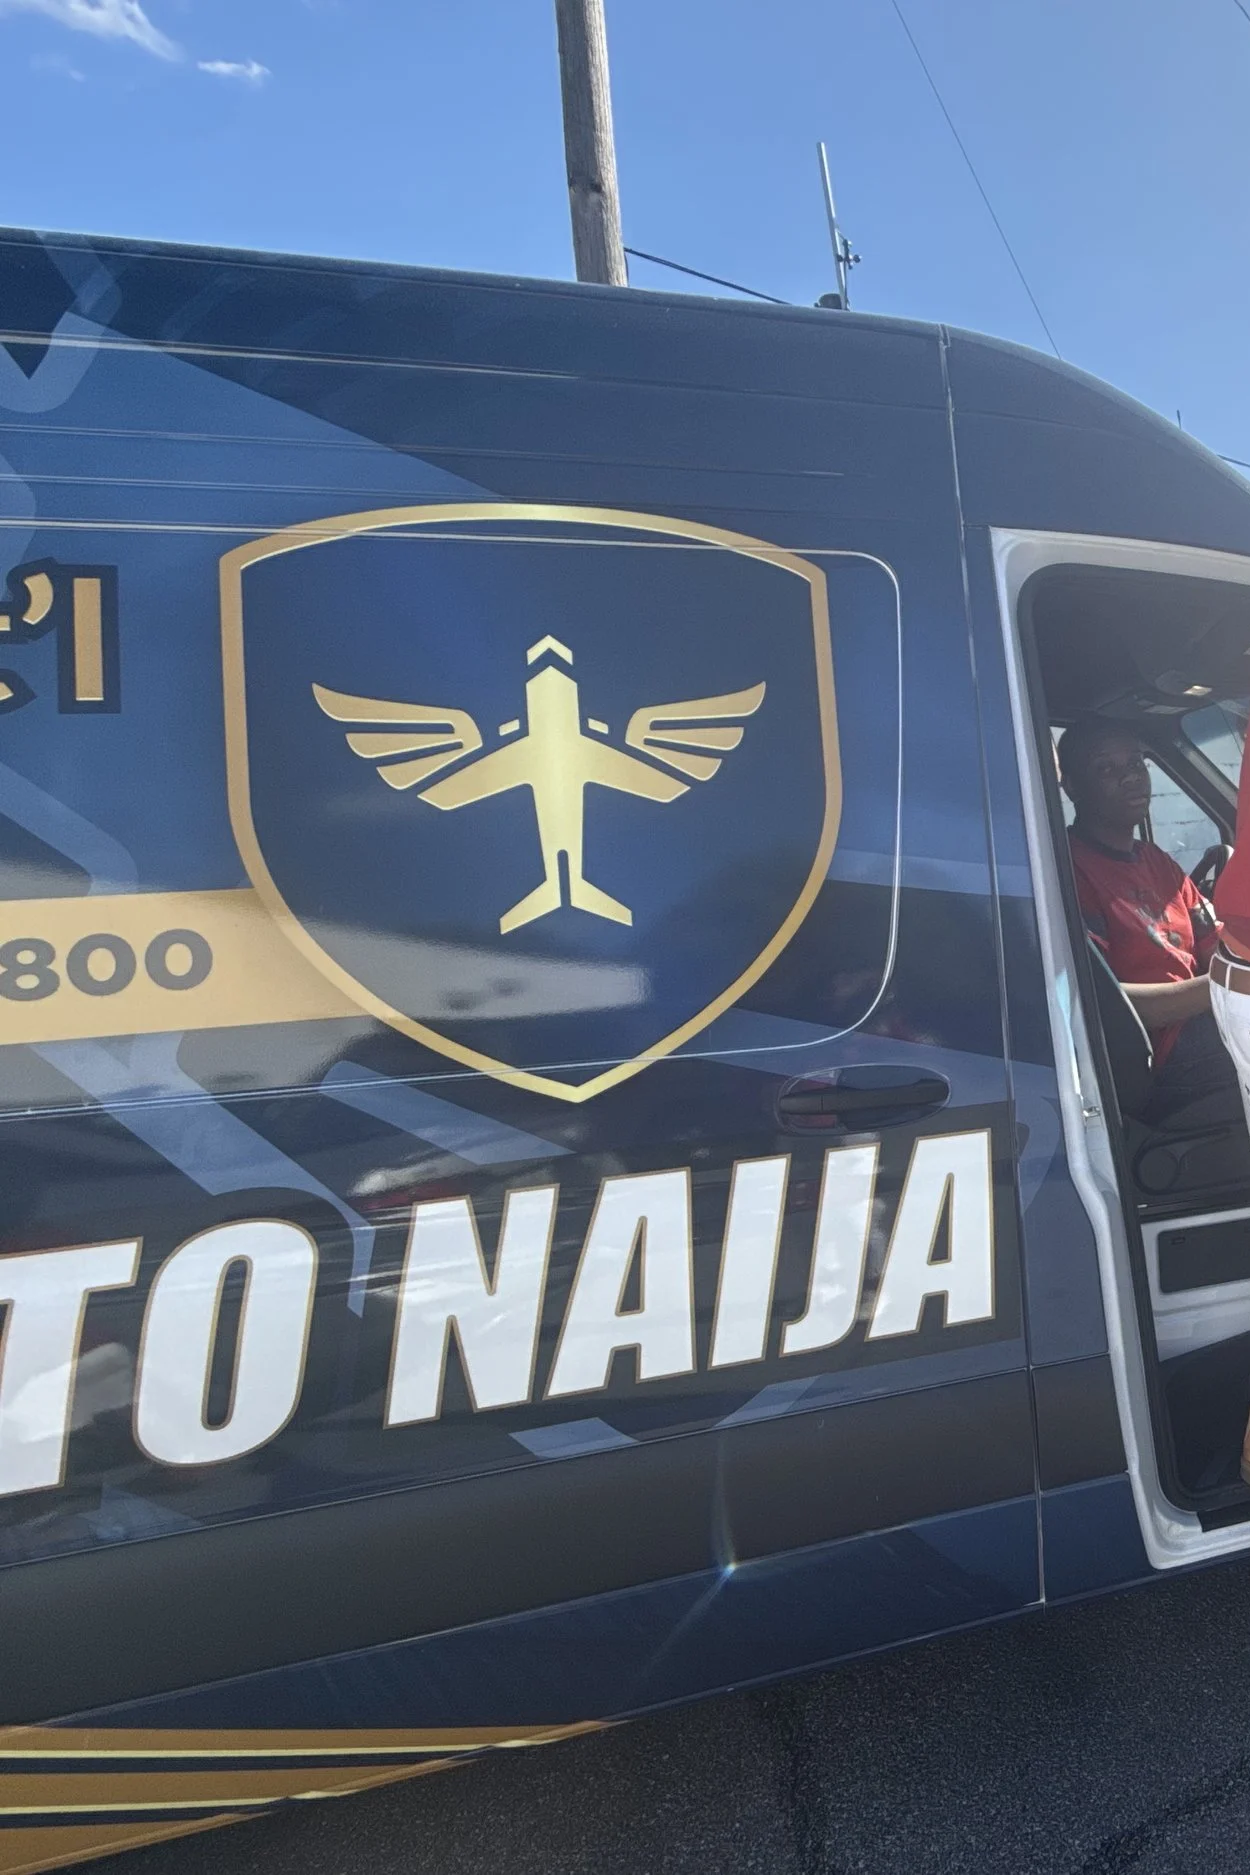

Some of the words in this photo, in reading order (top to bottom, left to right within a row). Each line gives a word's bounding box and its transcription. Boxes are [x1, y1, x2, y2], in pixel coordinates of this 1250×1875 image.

[0, 928, 213, 1001] 800
[0, 1217, 319, 1497] TO
[383, 1127, 996, 1428] NAIJA
